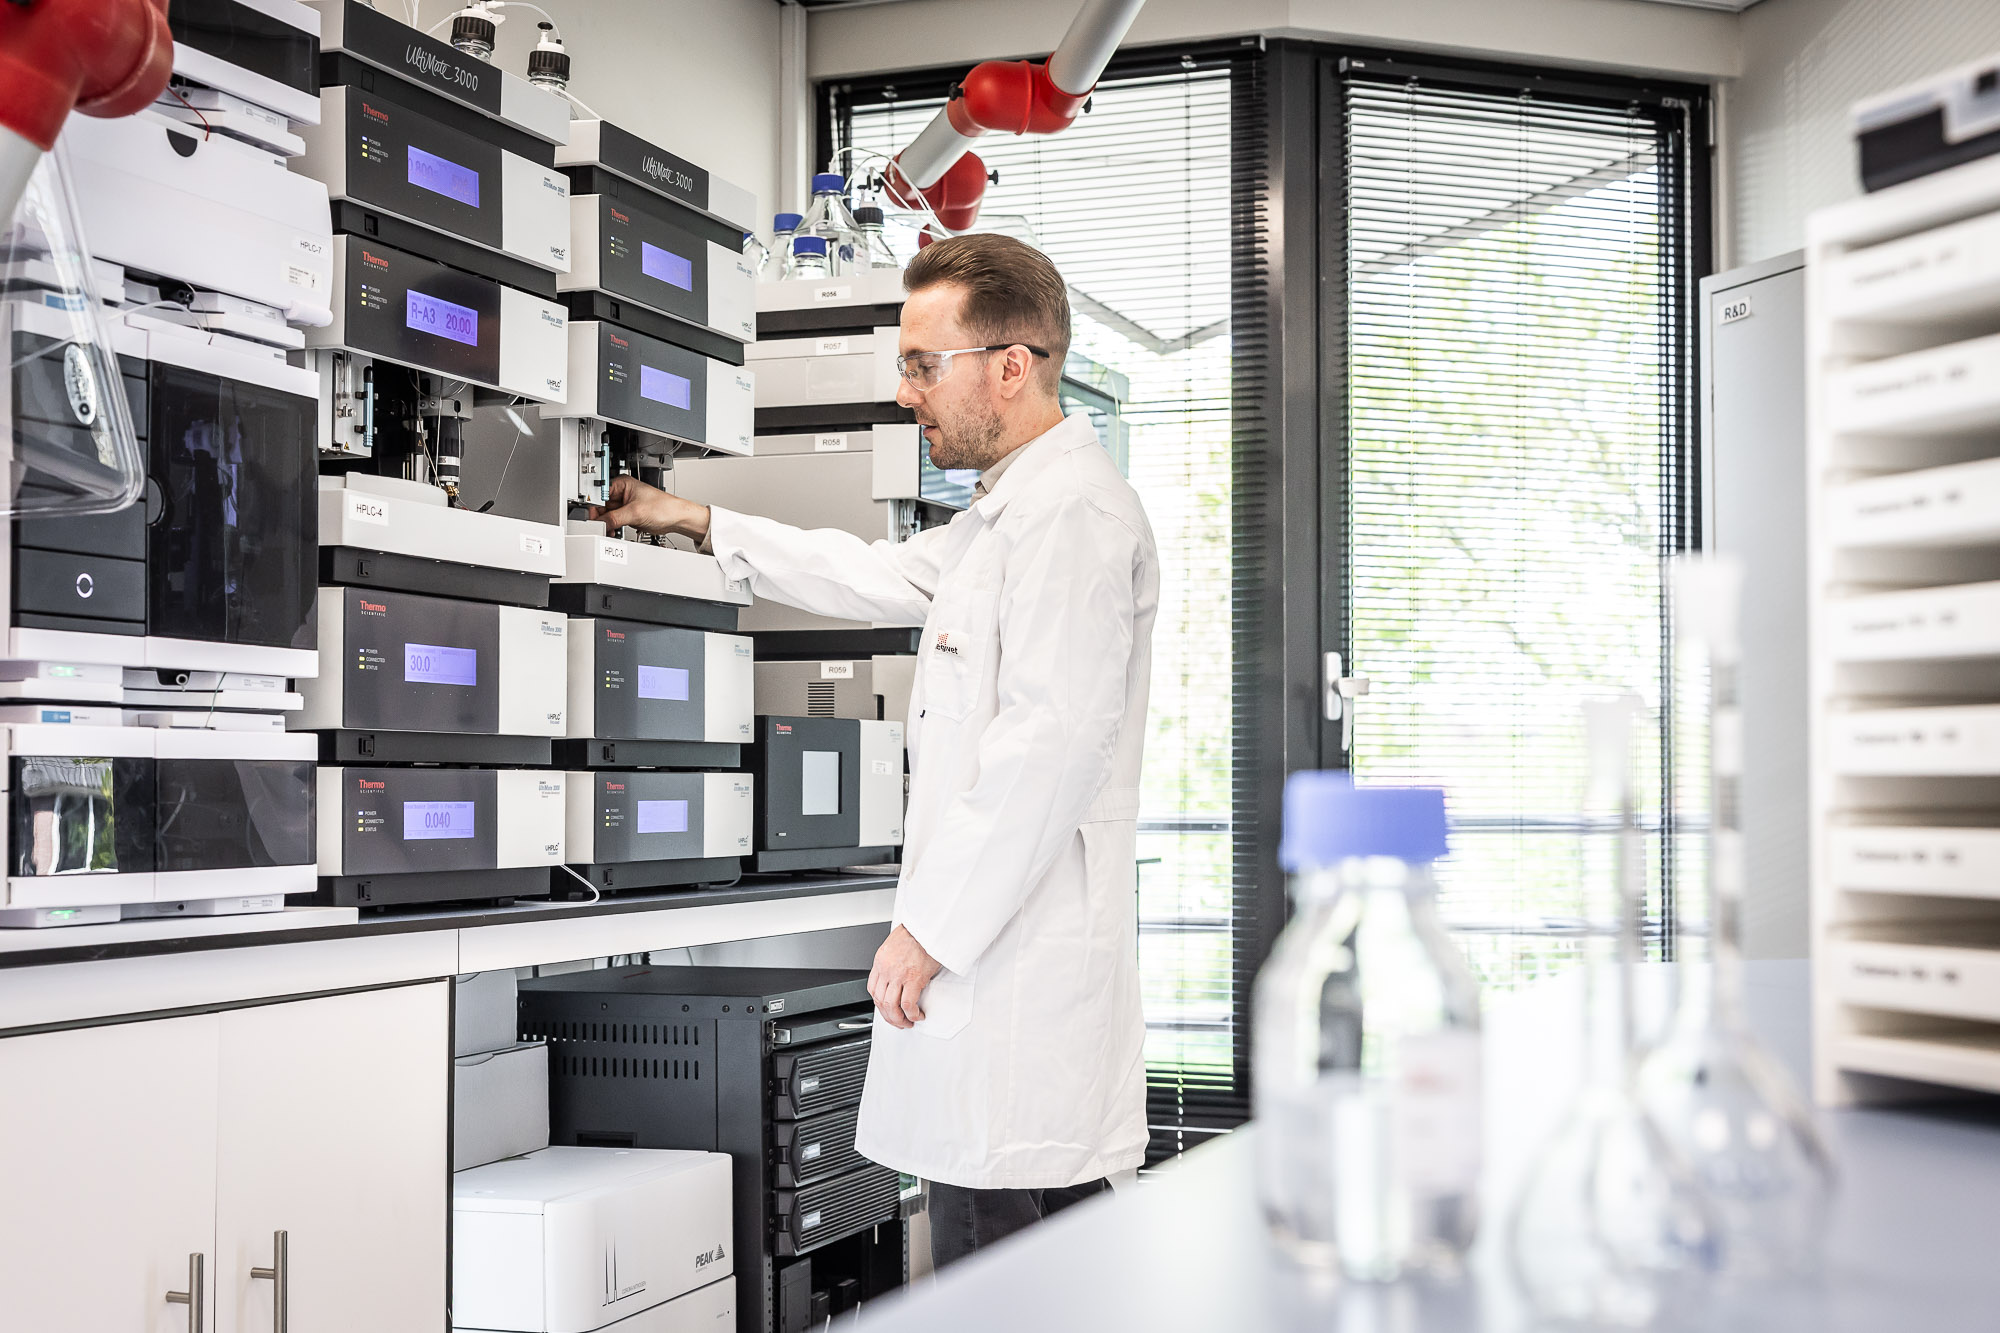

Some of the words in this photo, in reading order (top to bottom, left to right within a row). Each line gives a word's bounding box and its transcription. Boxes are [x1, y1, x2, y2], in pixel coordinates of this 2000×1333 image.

[406, 44, 453, 80] UltiMate
[454, 67, 479, 91] 3000
[362, 103, 389, 121] Thermo
[642, 155, 675, 183] UltiMate
[675, 171, 693, 192] 3000
[611, 207, 630, 223] Thermo
[299, 240, 322, 254] HPLC-7
[362, 251, 389, 268] Thermo
[1724, 302, 1747, 320] R&D
[411, 302, 436, 325] R-A3
[446, 313, 472, 335] 20.00
[610, 333, 629, 347] Thermo
[823, 342, 842, 350] R057
[822, 438, 841, 446] R058
[356, 503, 383, 518] HPLC-4
[604, 546, 624, 559] HPLC-3
[360, 600, 386, 613] Thermo
[361, 610, 386, 618] SCIENTIFIC
[606, 629, 625, 639] Thermo
[410, 655, 431, 672] 30.0
[828, 666, 847, 674] R059
[776, 723, 792, 731] Thermo
[359, 779, 385, 789] Thermo
[606, 781, 625, 790] Thermo
[425, 811, 451, 828] 0.040
[695, 1250, 714, 1268] PEAK
